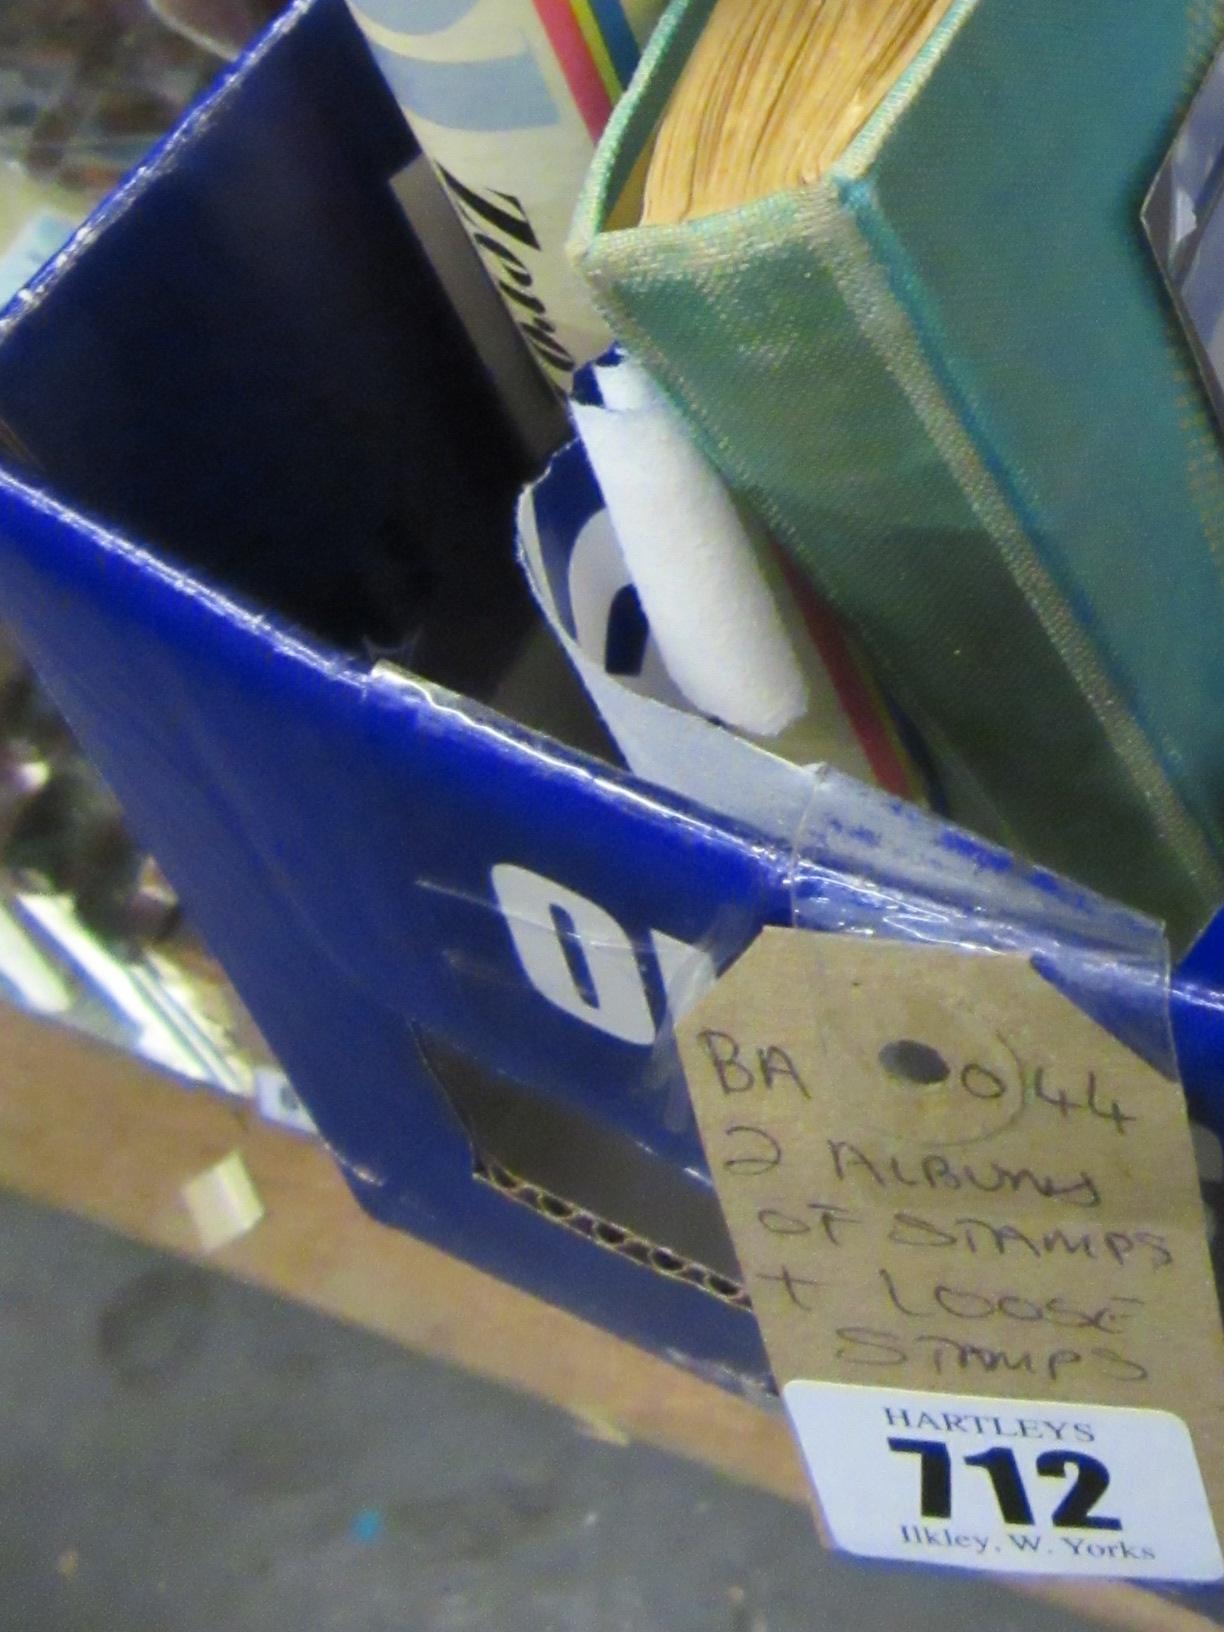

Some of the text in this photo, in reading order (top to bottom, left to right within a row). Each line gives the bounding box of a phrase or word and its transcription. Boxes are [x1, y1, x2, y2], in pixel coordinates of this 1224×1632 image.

[699, 1028, 811, 1102] BA
[723, 1125, 781, 1176] 2
[883, 1405, 1096, 1444] HARTLEYS
[887, 1437, 1123, 1532] 712
[1060, 1532, 1157, 1563] Yorks
